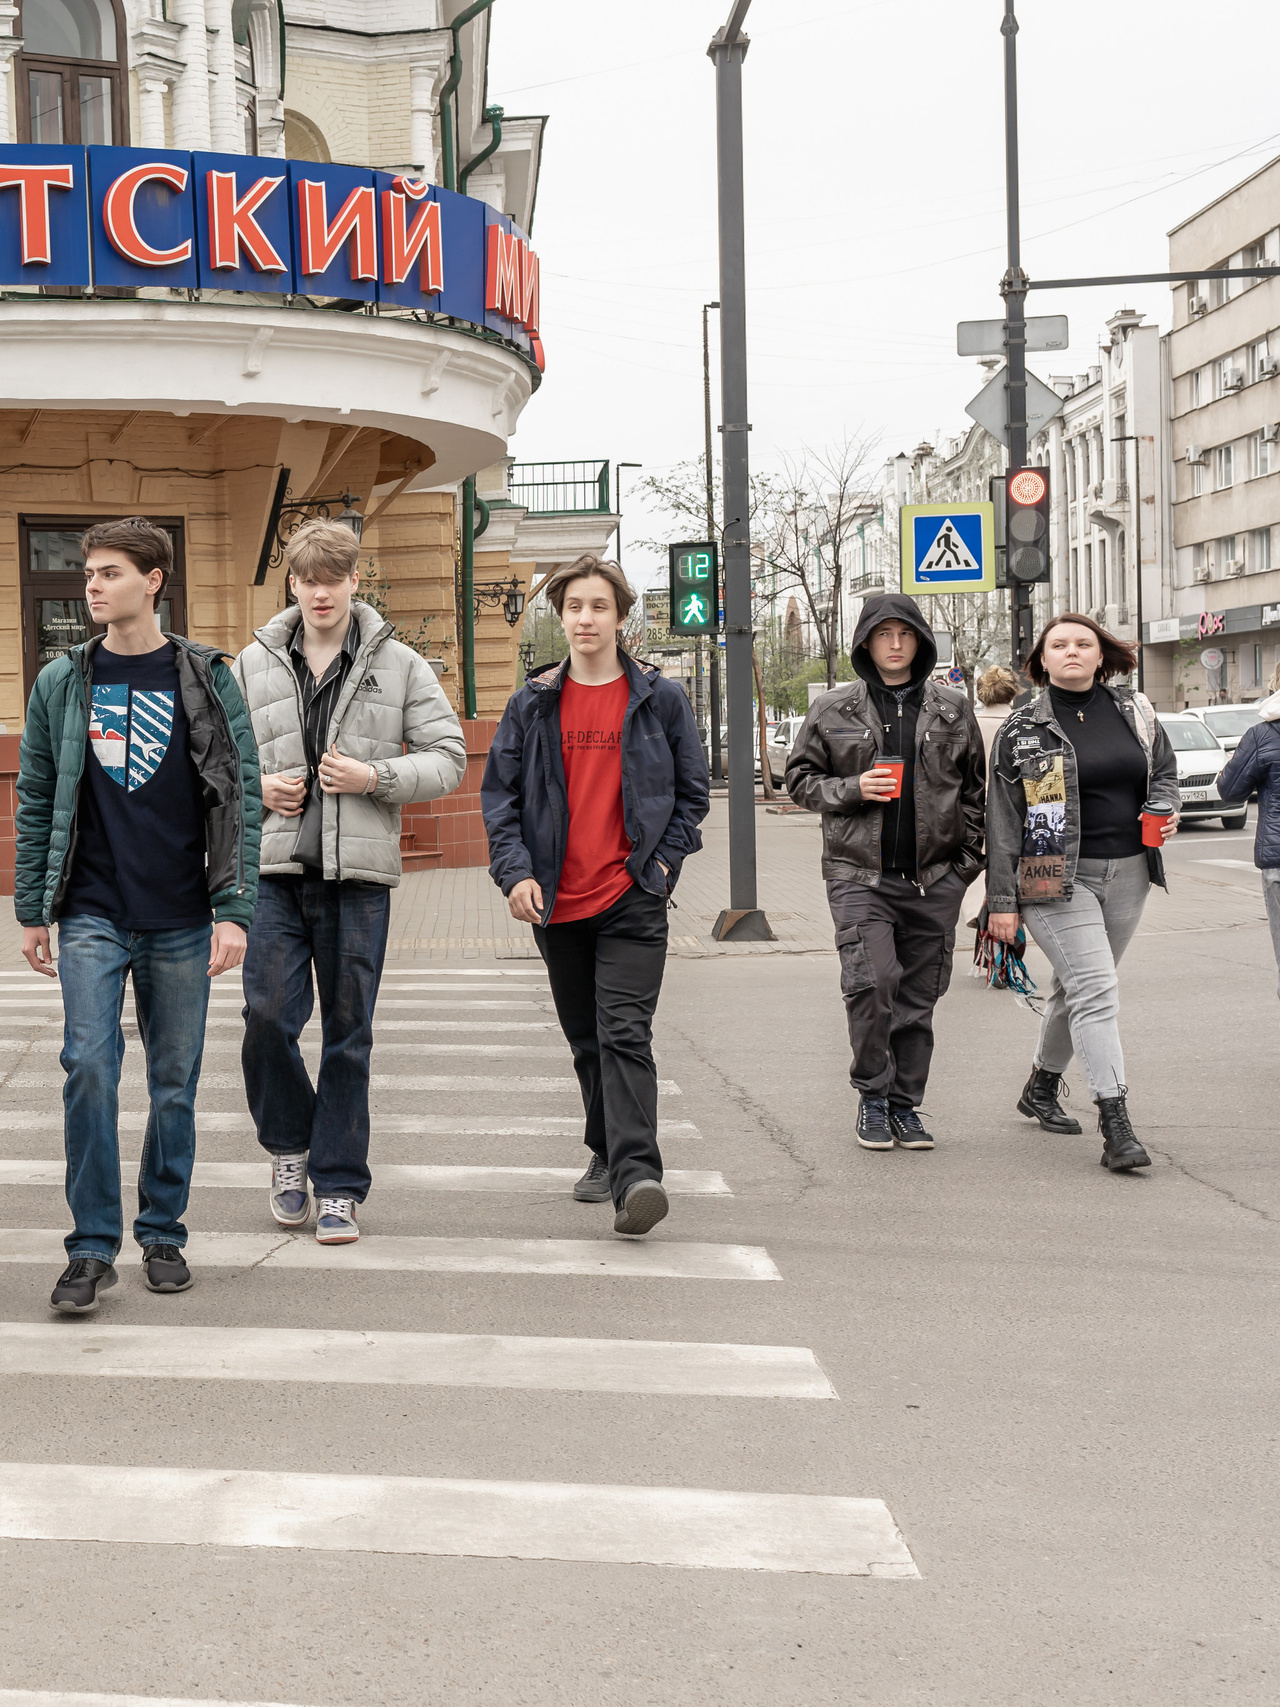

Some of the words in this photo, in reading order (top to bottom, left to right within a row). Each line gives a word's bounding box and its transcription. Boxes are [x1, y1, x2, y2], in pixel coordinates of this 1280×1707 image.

[486, 223, 545, 373] МИ
[688, 554, 709, 578] 12
[561, 730, 622, 744] LF-DECLA
[1039, 793, 1063, 804] HANNA
[1024, 864, 1062, 880] AKNE
